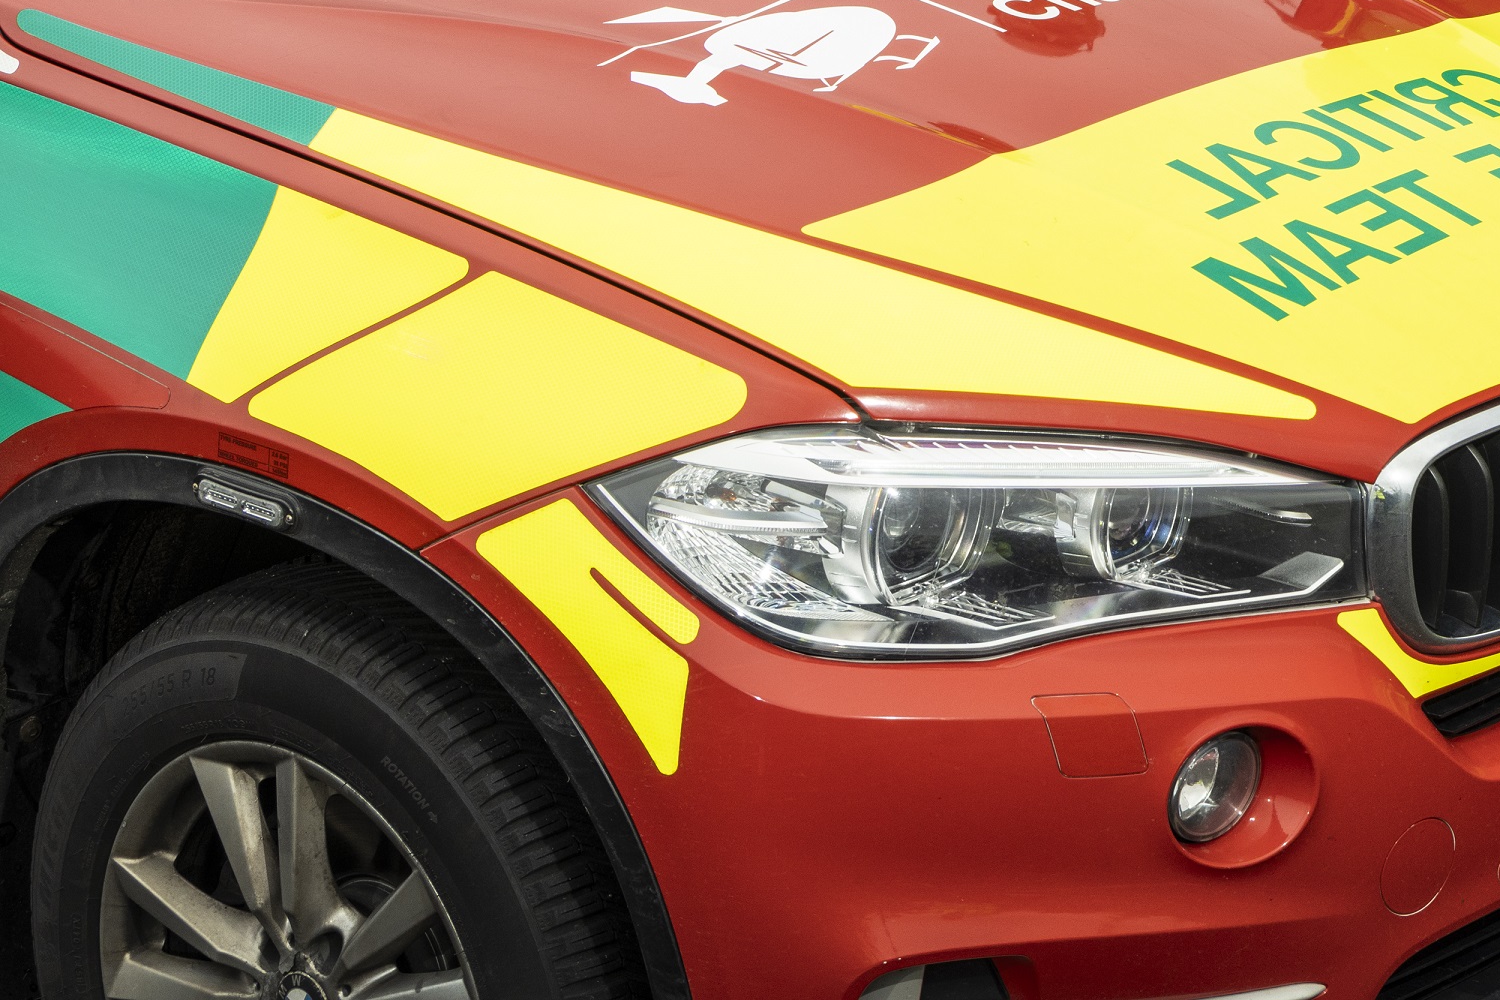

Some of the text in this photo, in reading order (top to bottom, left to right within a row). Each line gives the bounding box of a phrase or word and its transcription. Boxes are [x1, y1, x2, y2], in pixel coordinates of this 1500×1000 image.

[181, 669, 192, 688] R
[200, 667, 216, 686] 18
[380, 755, 429, 811] ROTATION
